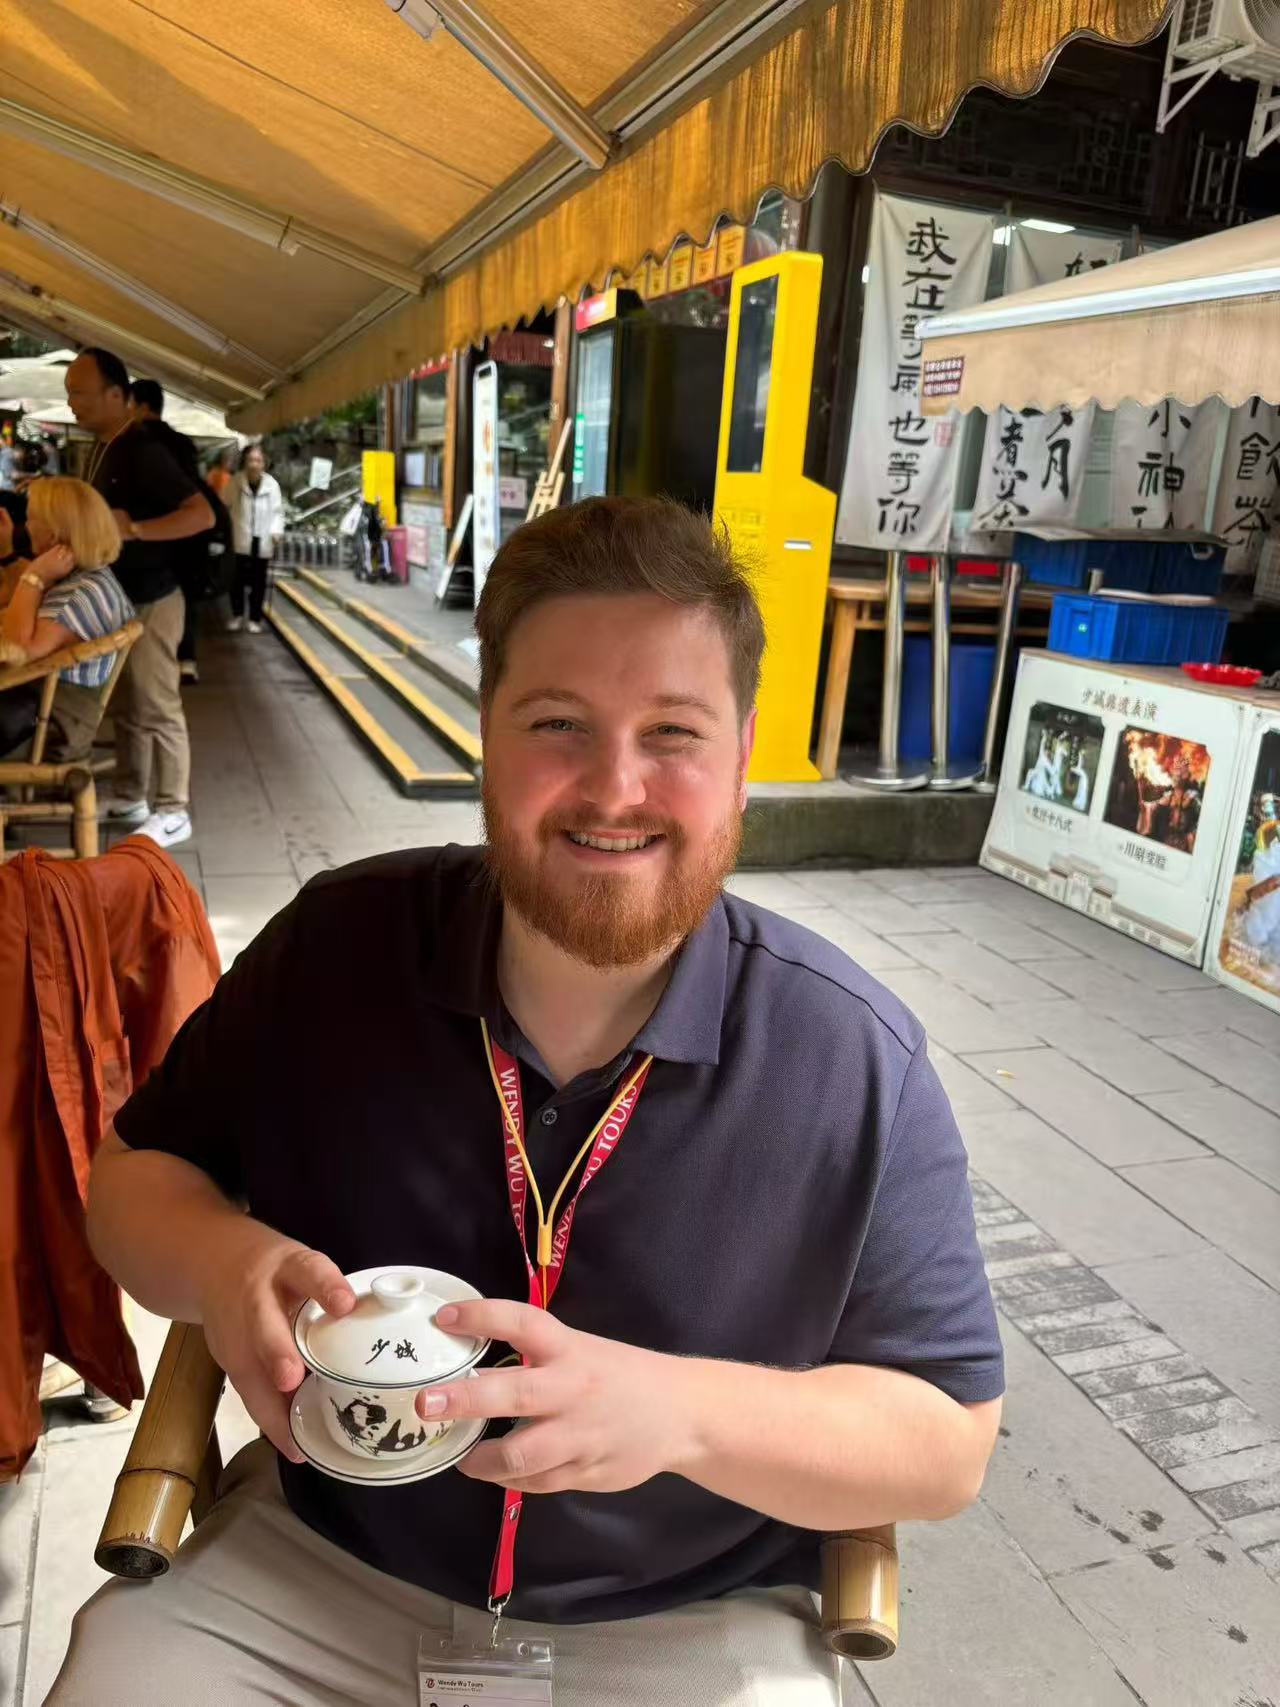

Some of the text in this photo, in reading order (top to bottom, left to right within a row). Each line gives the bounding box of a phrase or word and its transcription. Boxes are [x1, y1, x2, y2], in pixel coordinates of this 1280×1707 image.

[508, 1154, 524, 1192] WU
[512, 1199, 523, 1237] TO
[366, 1338, 418, 1365] 少城
